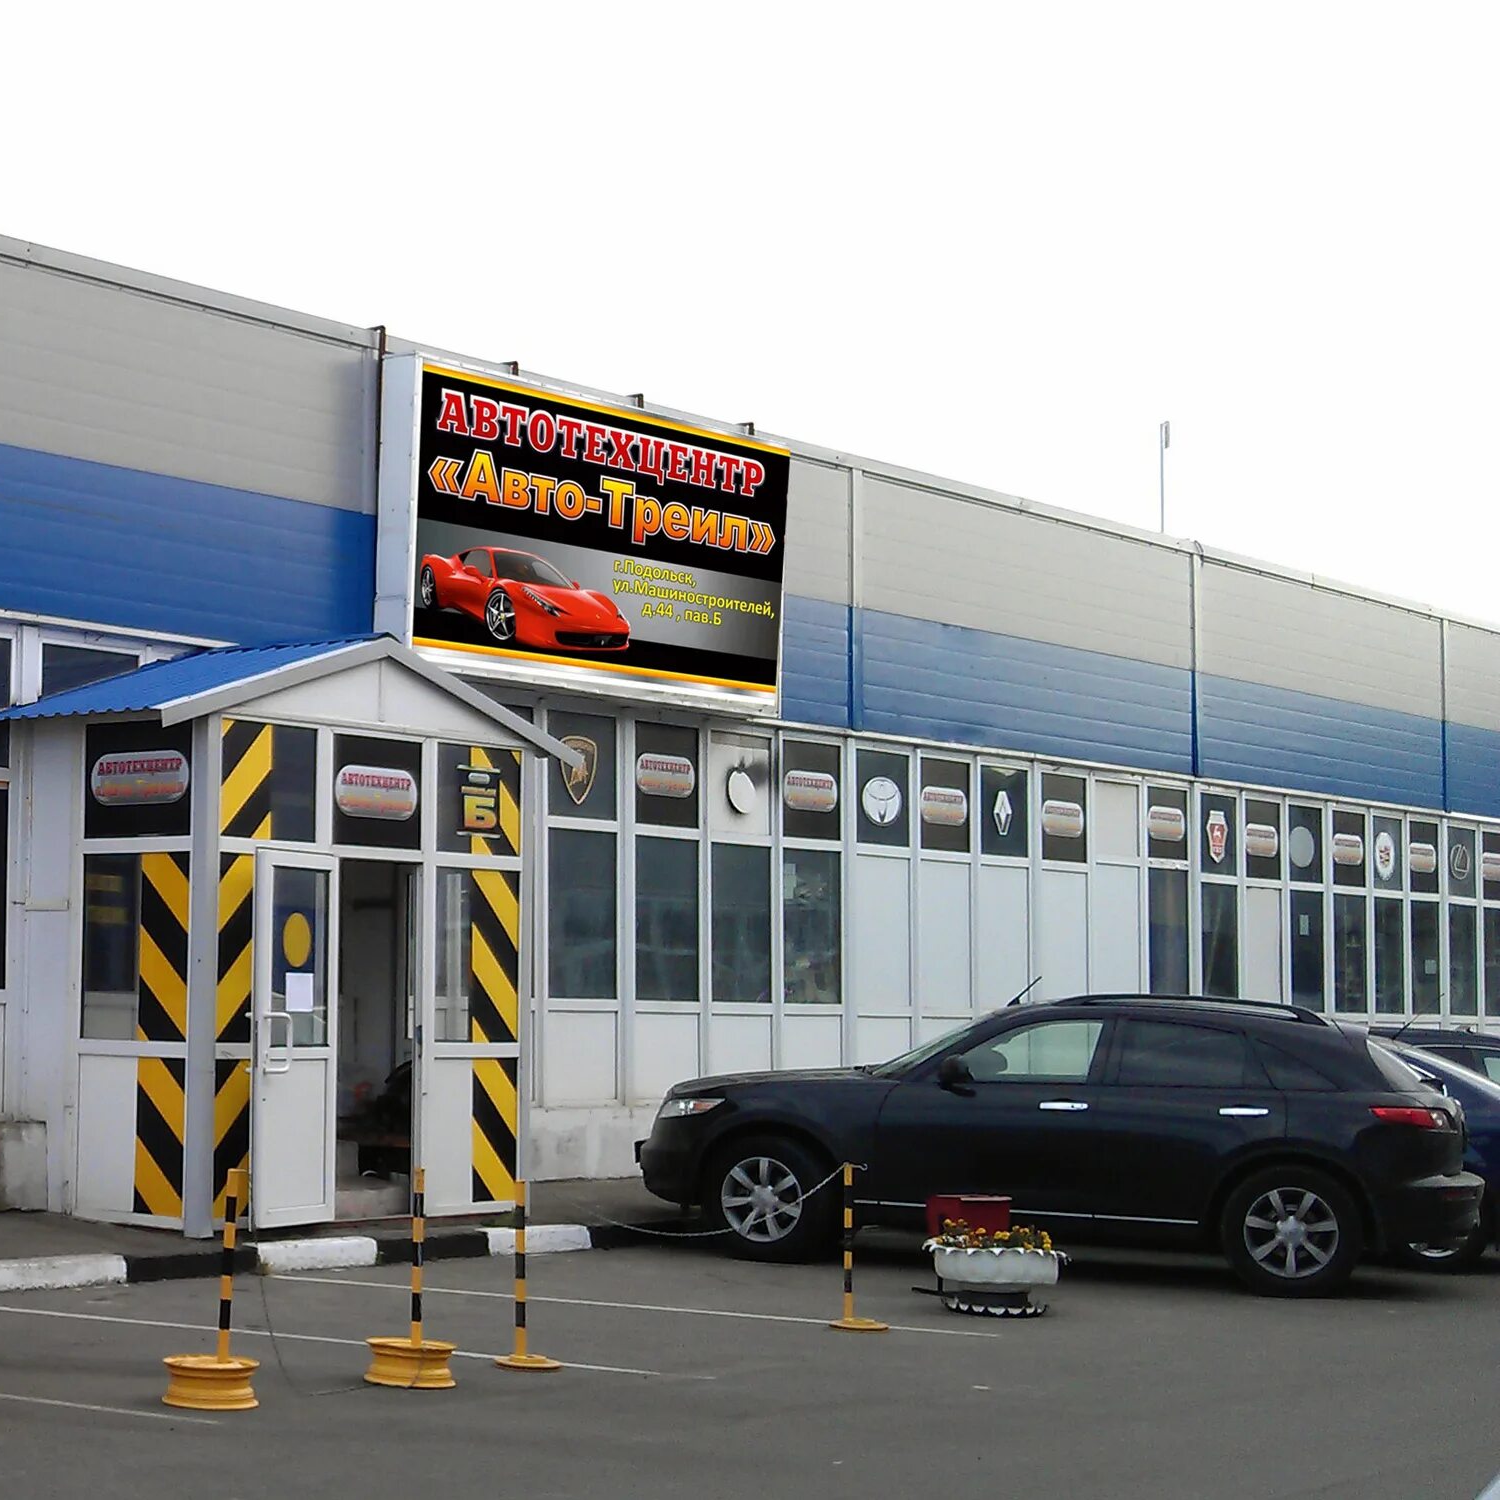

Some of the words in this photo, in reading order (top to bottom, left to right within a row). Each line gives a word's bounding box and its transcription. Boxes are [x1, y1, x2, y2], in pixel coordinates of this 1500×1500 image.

[437, 387, 765, 498] АВТОТЕХЦЕНТР
[428, 449, 776, 555] «Авто-Треил»
[613, 559, 696, 588] г.Подольск,
[613, 578, 775, 619] ул.Машиностроителей,
[684, 609, 722, 626] пав.Б
